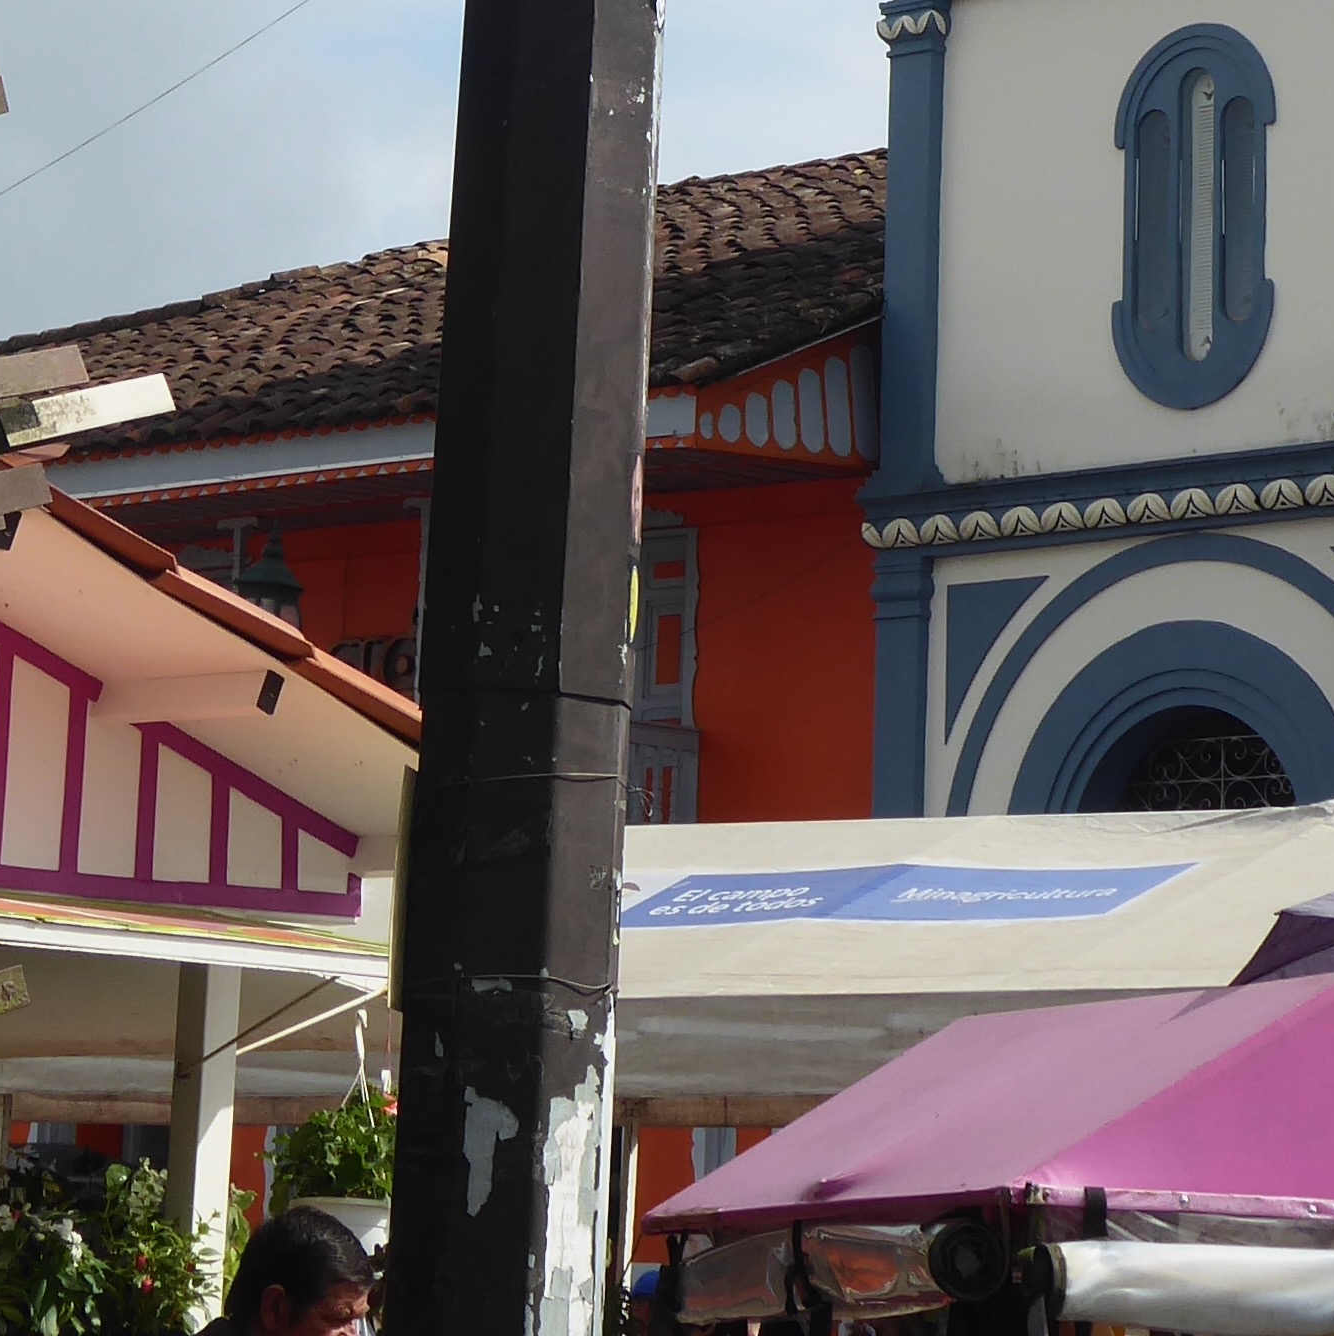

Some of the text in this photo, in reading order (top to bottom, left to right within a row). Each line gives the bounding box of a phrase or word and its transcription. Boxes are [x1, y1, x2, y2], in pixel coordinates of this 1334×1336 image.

[673, 886, 810, 903] El campo
[893, 887, 1118, 905] Minagricultura
[649, 896, 824, 916] es de todos
